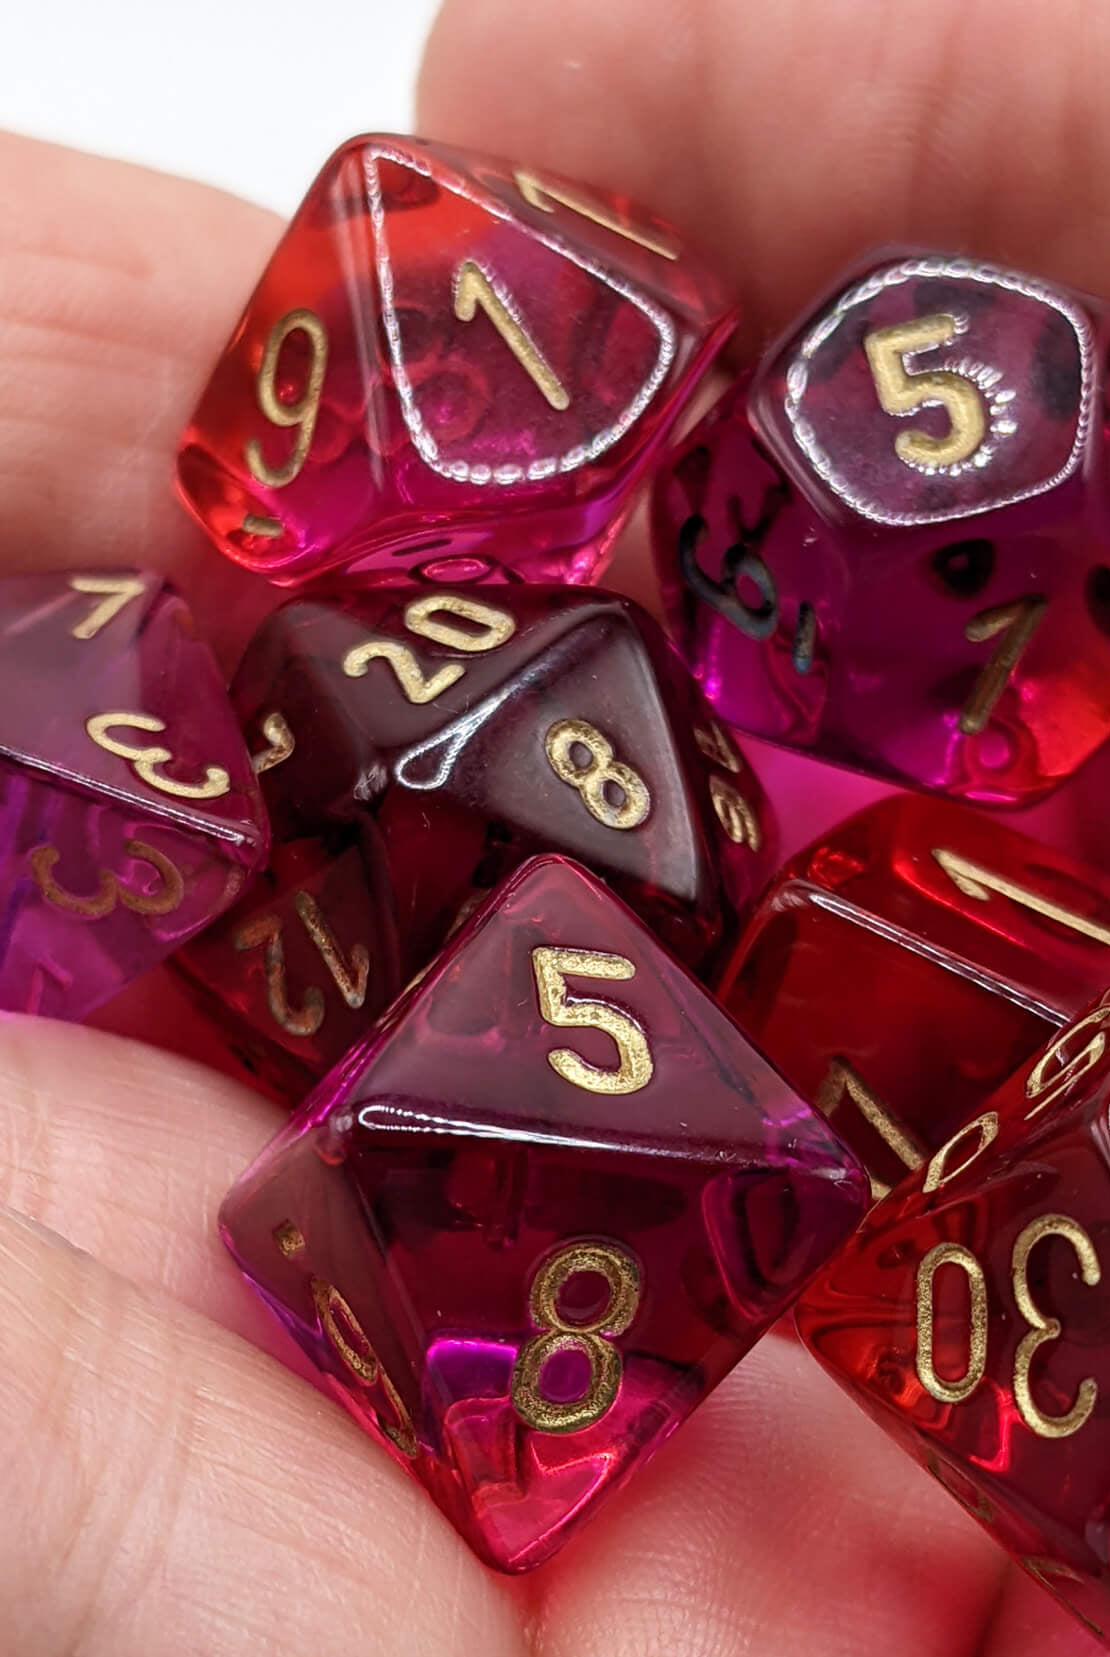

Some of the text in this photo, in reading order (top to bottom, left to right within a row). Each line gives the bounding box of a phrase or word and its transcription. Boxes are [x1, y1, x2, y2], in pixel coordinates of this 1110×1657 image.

[452, 258, 571, 412] 1
[863, 311, 987, 473] 5
[342, 595, 516, 704] 20
[86, 711, 231, 800] 3
[543, 718, 652, 830] 8
[530, 945, 655, 1096] 5
[509, 1242, 642, 1434] 8
